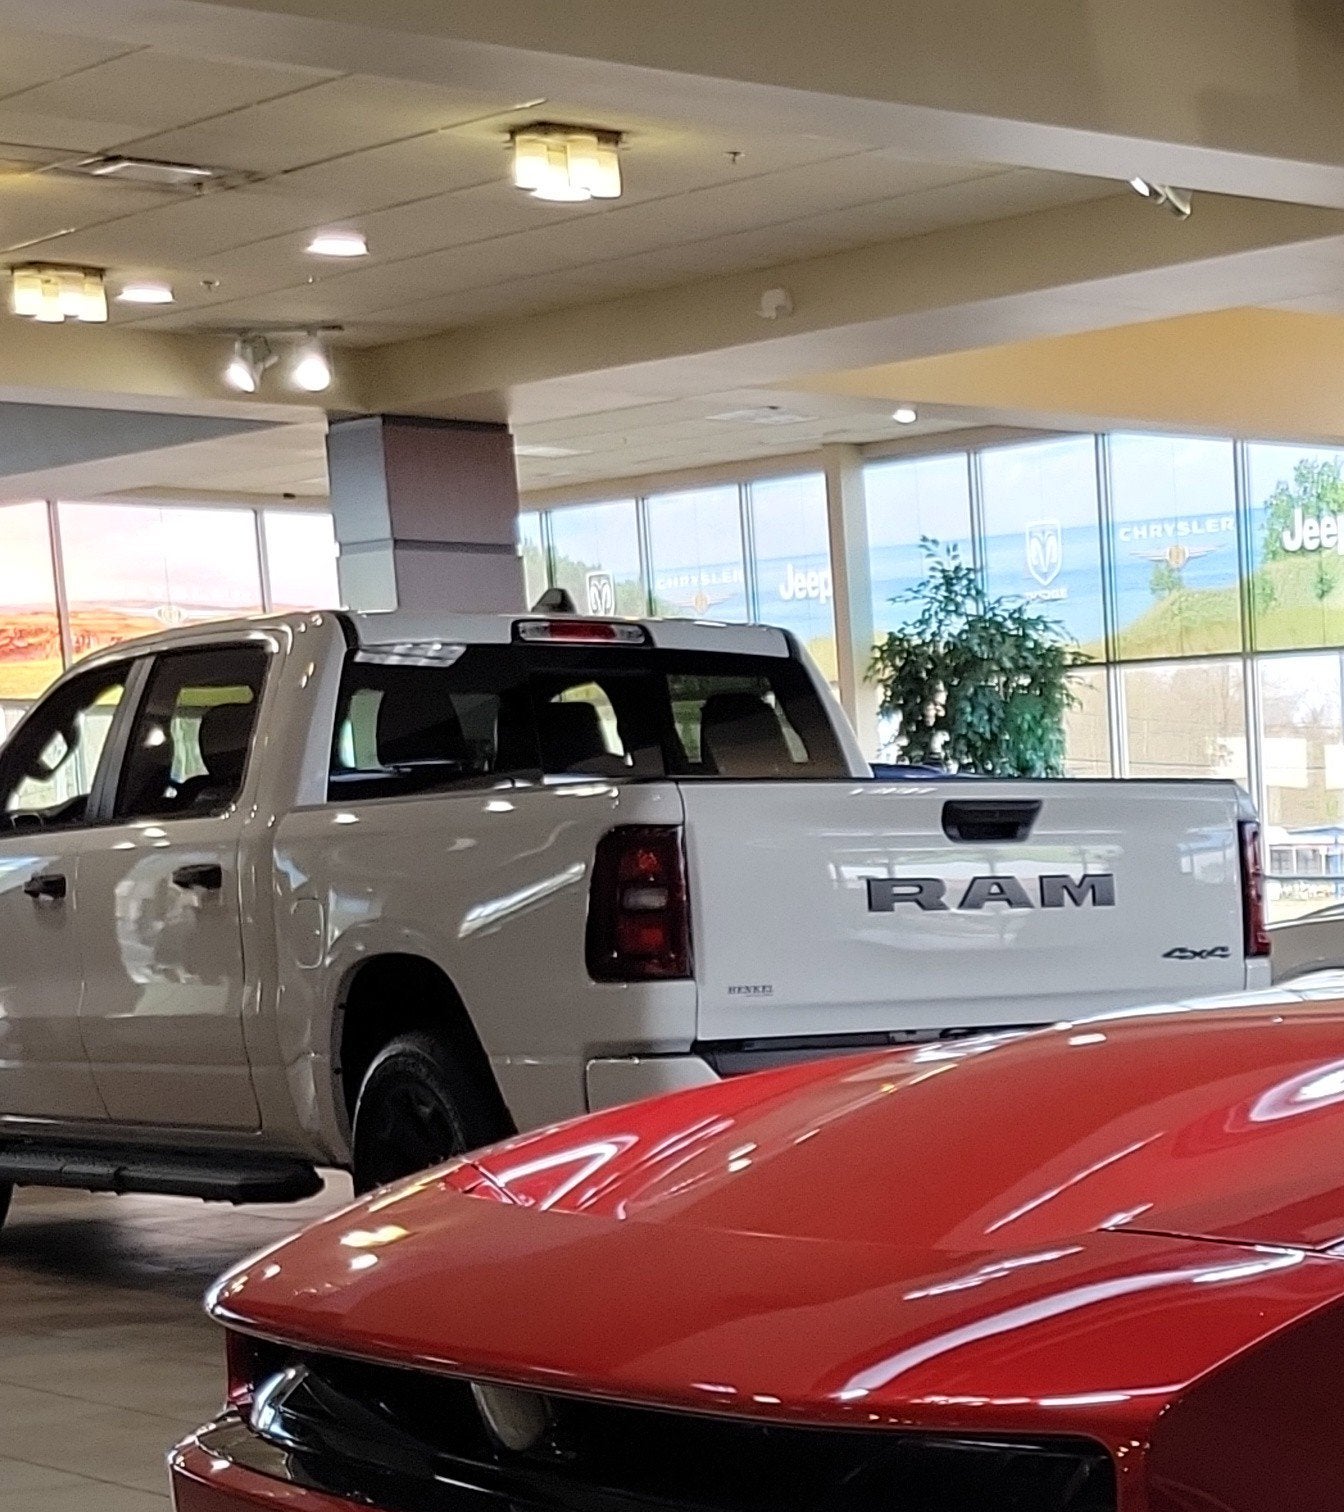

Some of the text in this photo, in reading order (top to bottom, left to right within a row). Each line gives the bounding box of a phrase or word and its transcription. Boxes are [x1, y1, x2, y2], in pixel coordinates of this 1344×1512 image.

[1118, 516, 1236, 541] CHRYSLER
[779, 563, 834, 605] Jeep
[866, 873, 1116, 912] RAM
